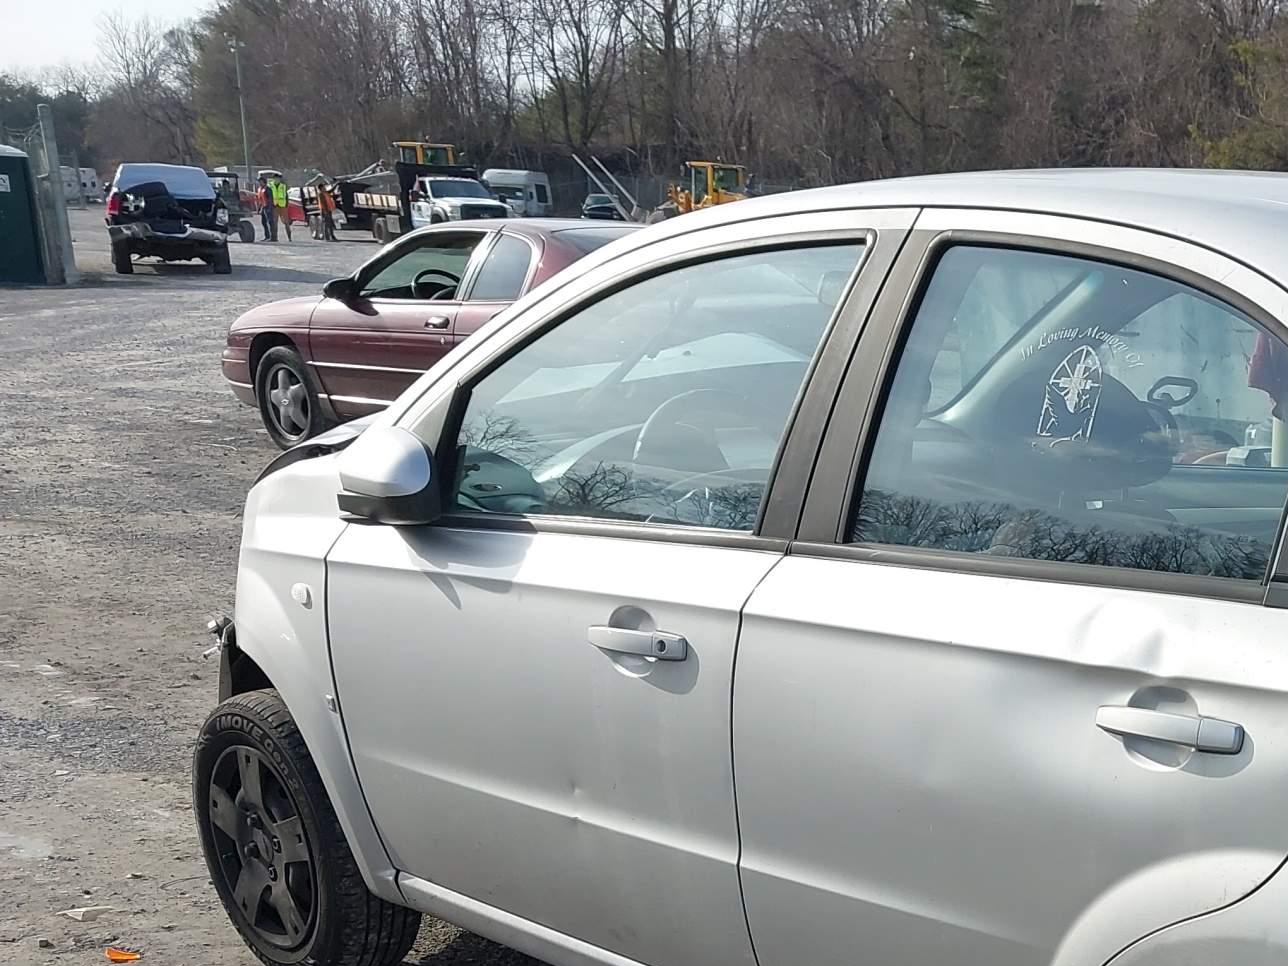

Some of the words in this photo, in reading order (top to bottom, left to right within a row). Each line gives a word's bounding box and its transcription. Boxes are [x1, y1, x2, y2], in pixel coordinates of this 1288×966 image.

[1020, 345, 1034, 361] In
[1038, 327, 1079, 350] Loving
[1079, 325, 1129, 352] Memory
